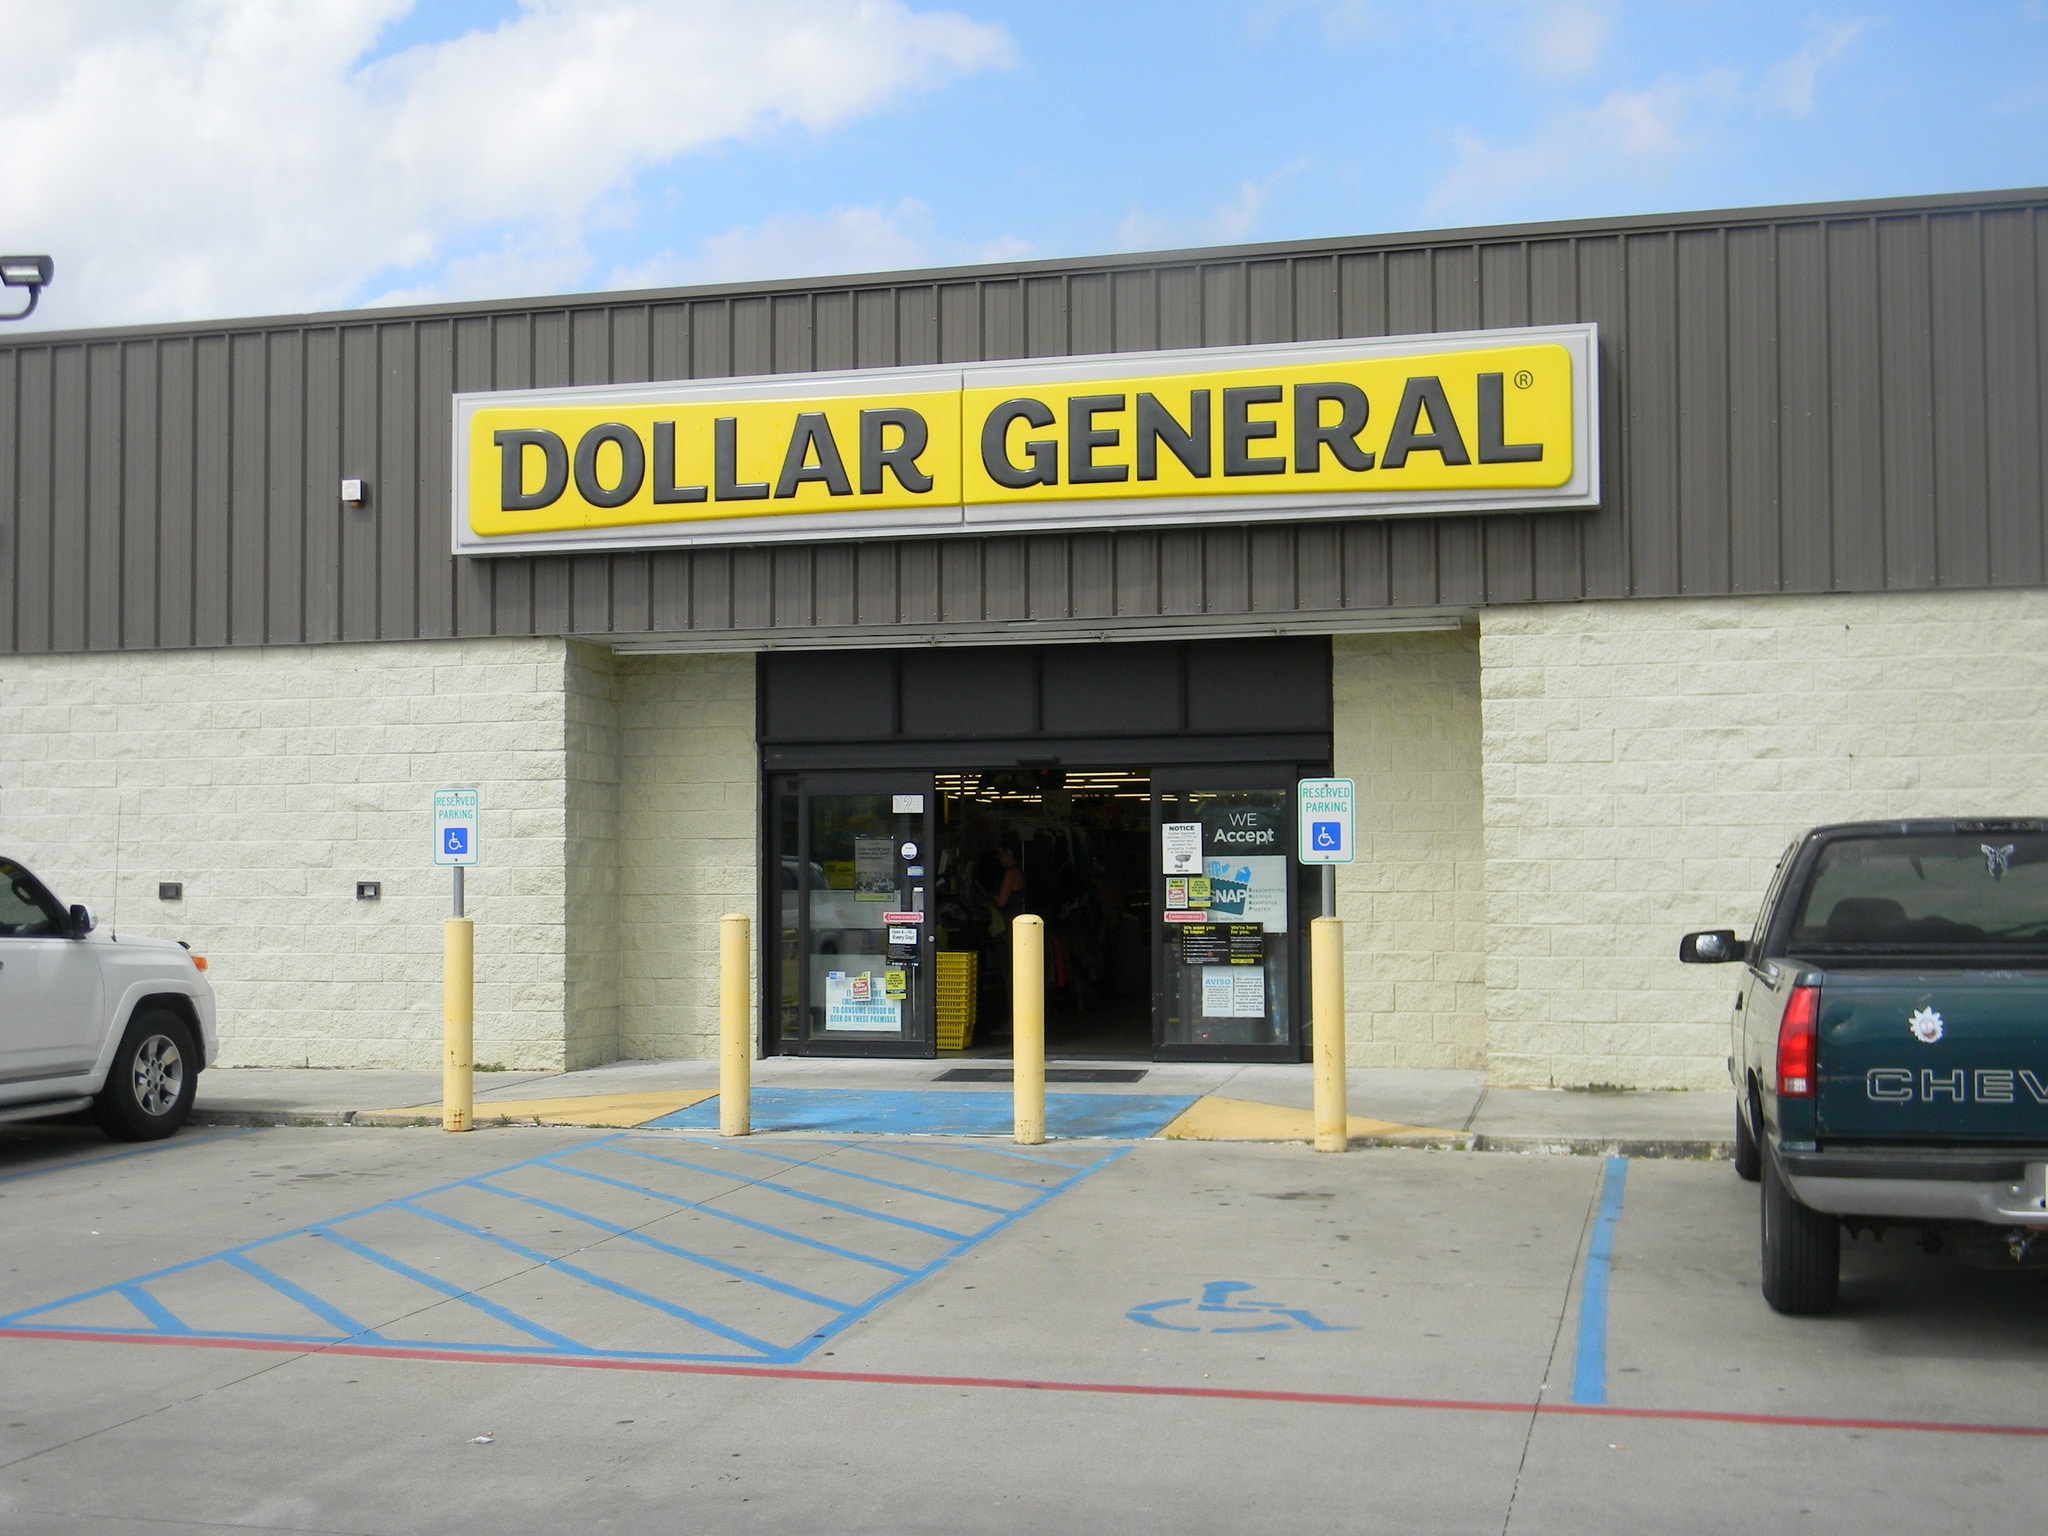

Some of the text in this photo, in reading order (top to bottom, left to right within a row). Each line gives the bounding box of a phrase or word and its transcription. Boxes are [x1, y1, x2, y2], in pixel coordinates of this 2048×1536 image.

[494, 408, 934, 511] DOLLAR
[981, 372, 1544, 489] GENERAL
[1302, 787, 1350, 798] RESERVED
[436, 796, 475, 806] RESERVED
[1306, 802, 1347, 812] PARKING
[439, 810, 473, 819] PARKING
[1228, 812, 1257, 826] WE
[1213, 828, 1275, 845] Accept
[832, 1006, 840, 1014] TO
[841, 1006, 866, 1014] CONSUME
[853, 1015, 869, 1023] THESE
[870, 1015, 897, 1023] PREMISES
